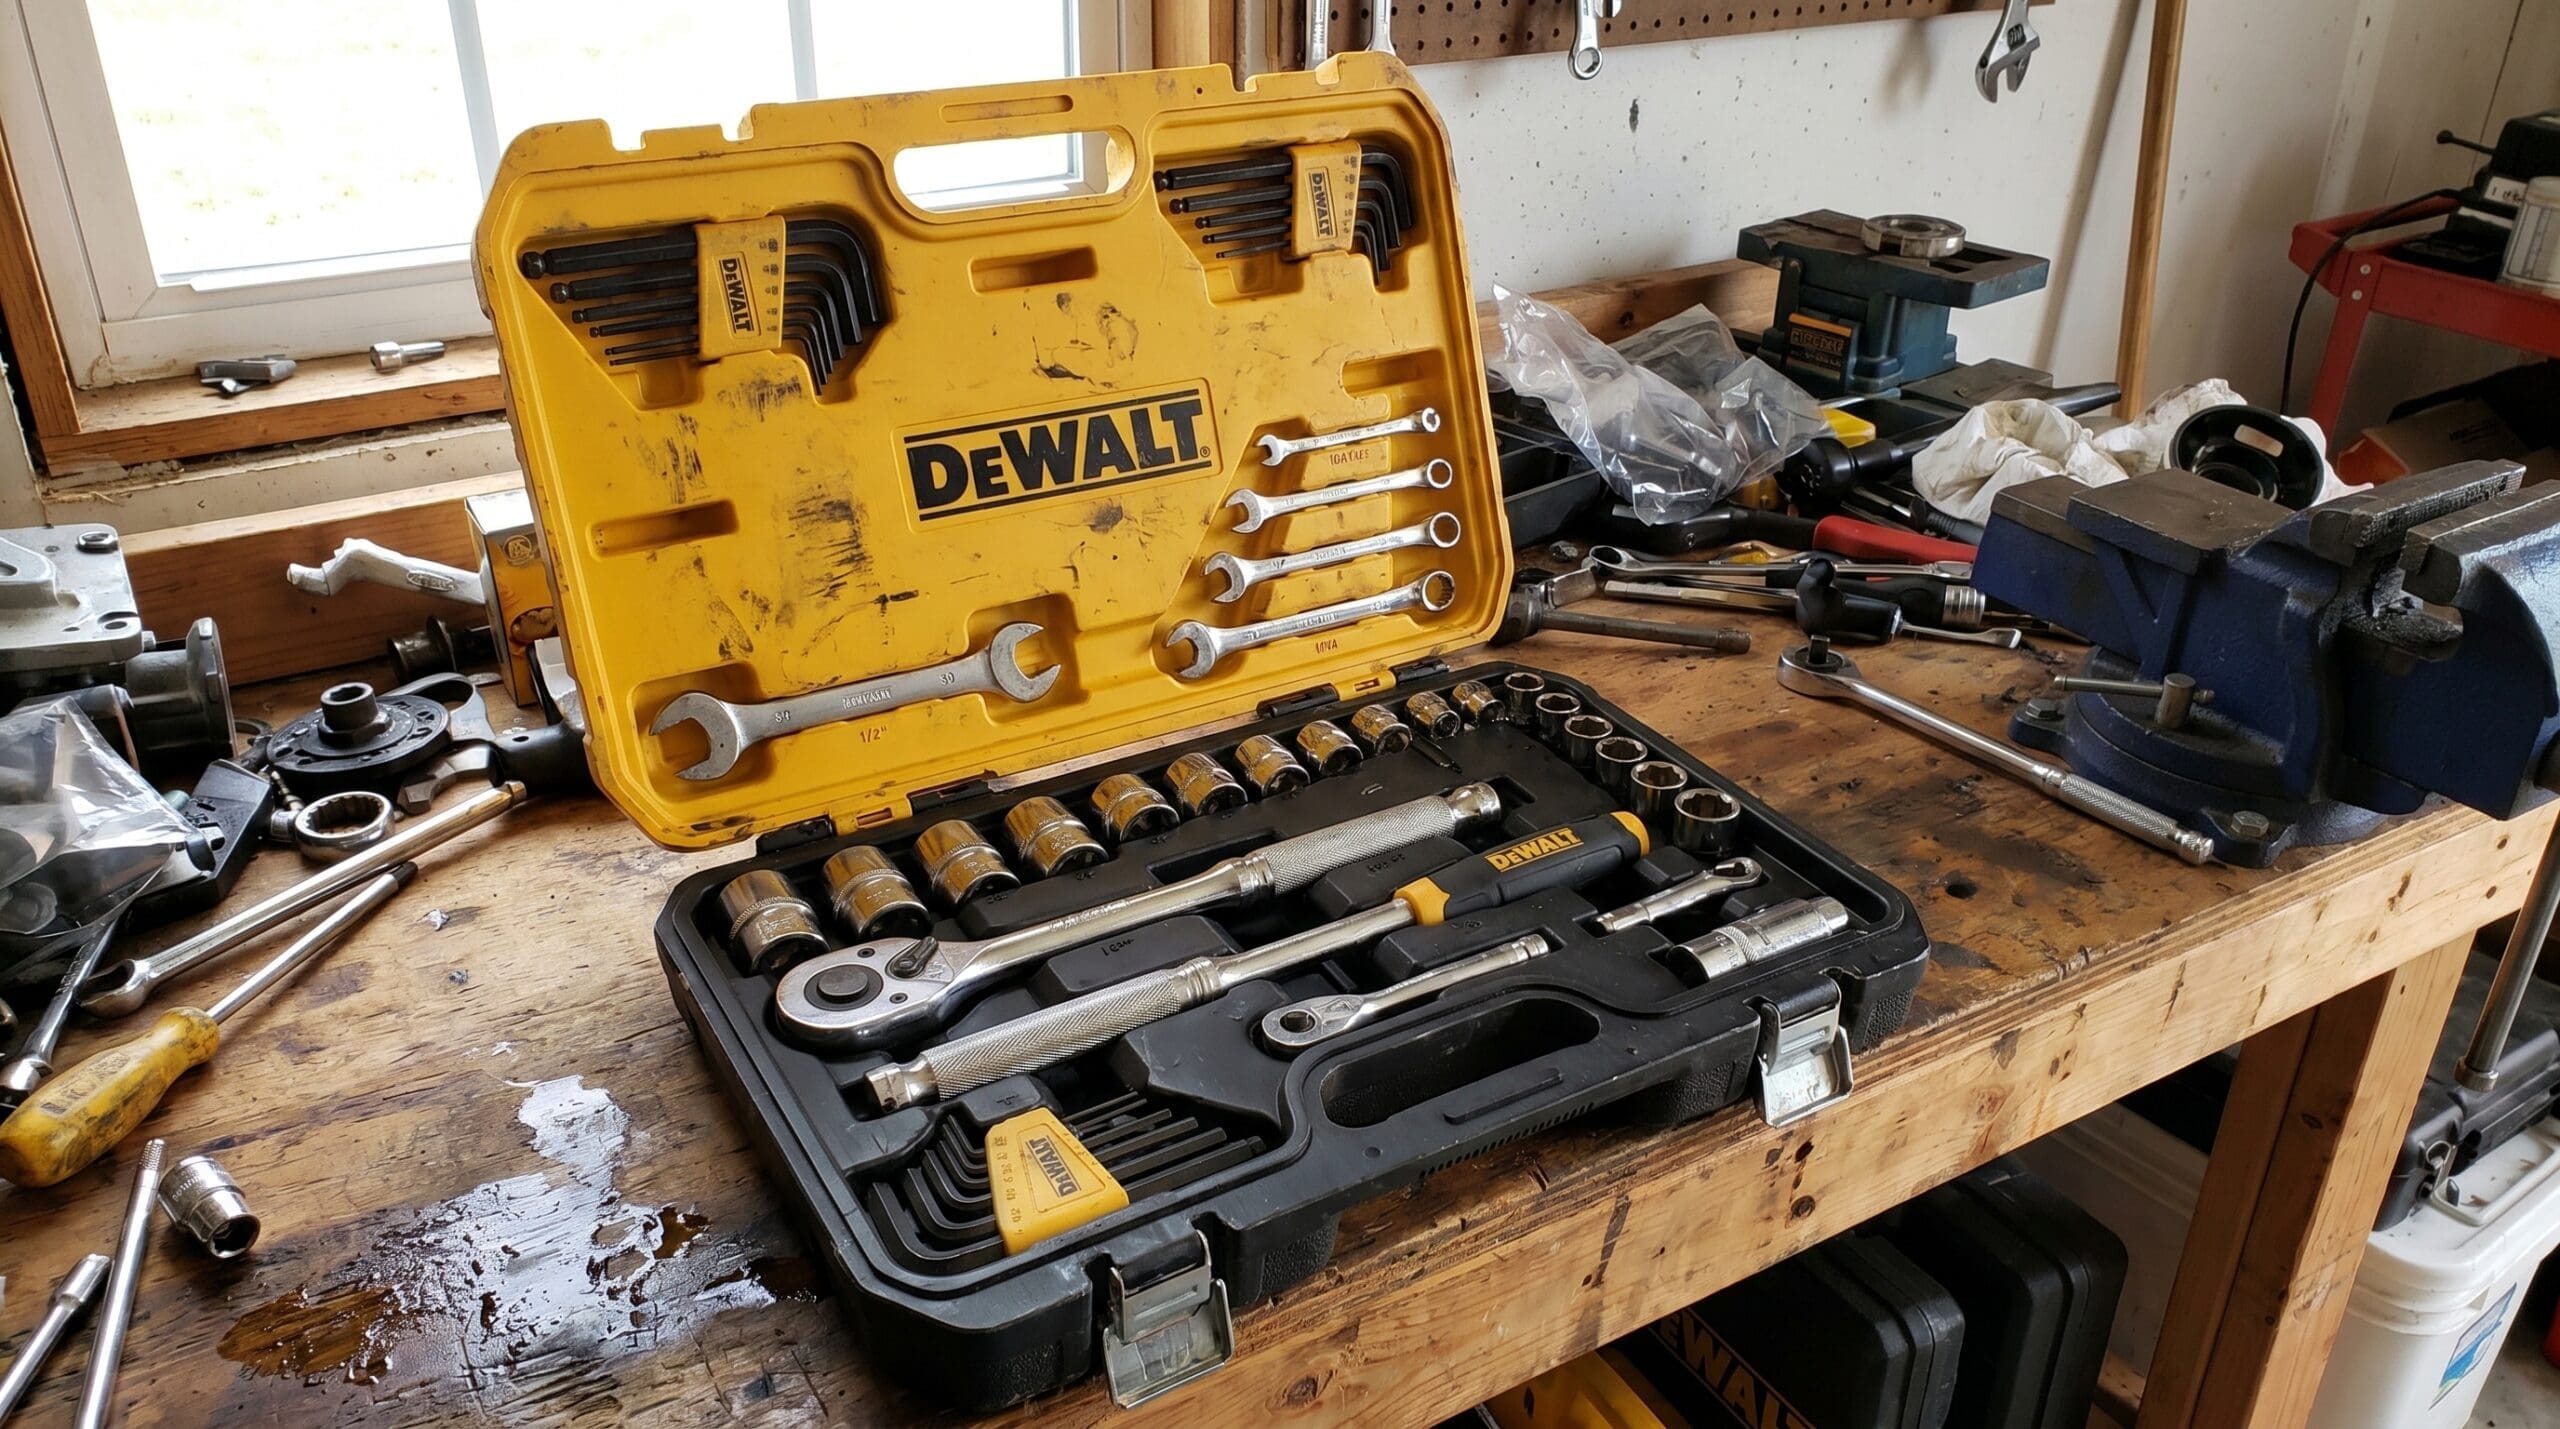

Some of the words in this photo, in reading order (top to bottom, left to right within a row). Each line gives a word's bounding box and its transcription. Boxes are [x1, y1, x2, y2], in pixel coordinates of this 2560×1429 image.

[721, 258, 751, 332] DEWALT
[906, 398, 1203, 510] DEWALT
[860, 725, 887, 744] 1/2"
[1486, 827, 1582, 871] DEWALT
